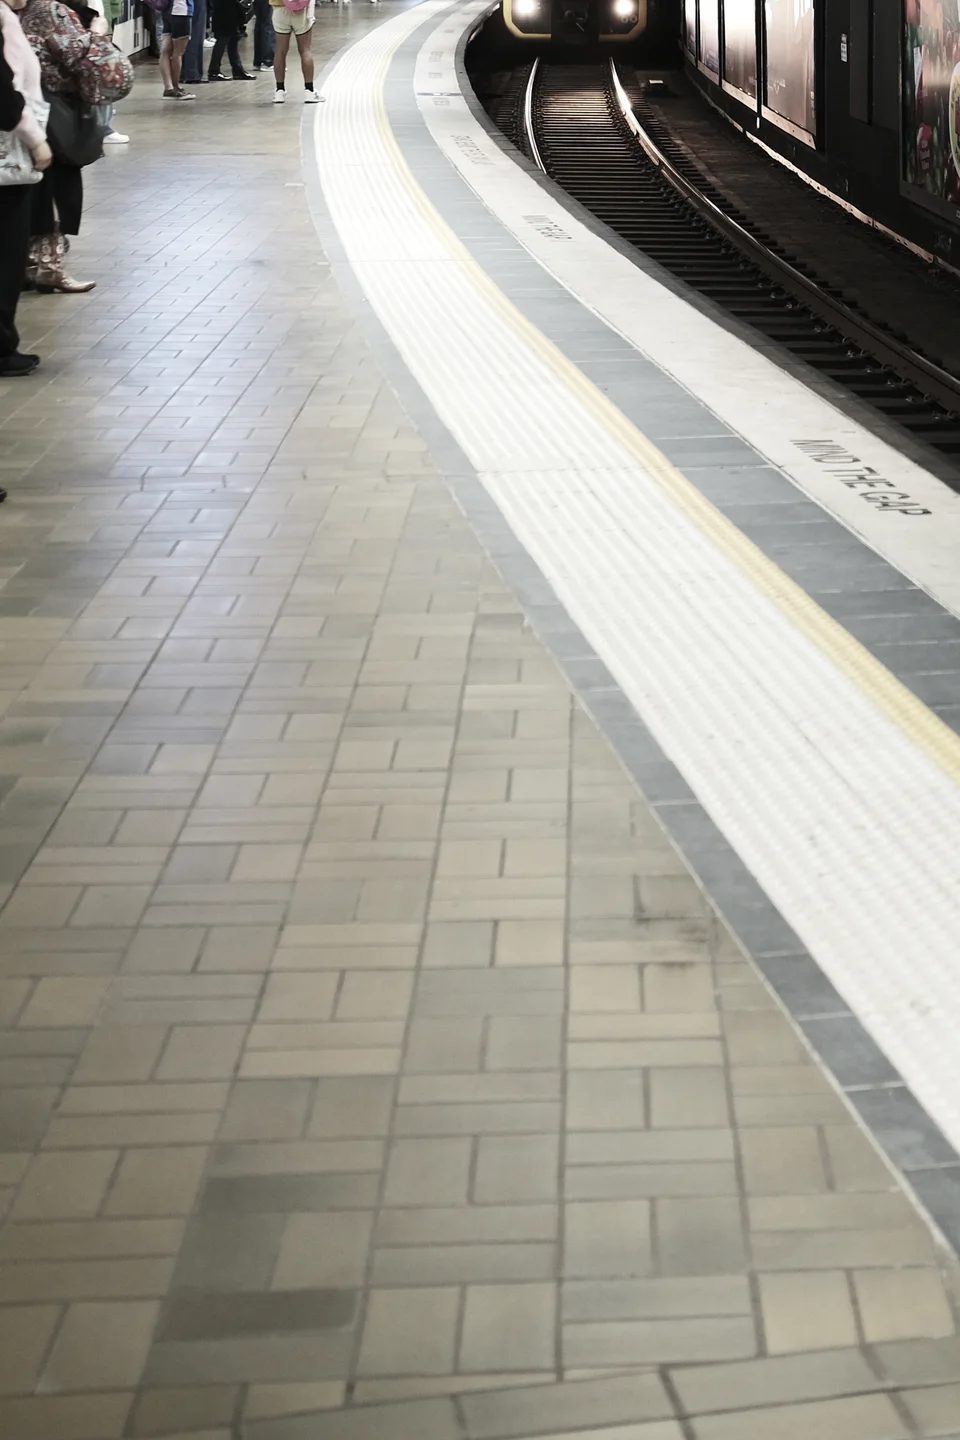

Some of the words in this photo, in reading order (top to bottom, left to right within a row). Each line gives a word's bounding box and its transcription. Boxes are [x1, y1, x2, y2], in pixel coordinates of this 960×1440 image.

[789, 439, 861, 464] MIND
[822, 466, 897, 489] THE
[859, 491, 933, 516] GAP
